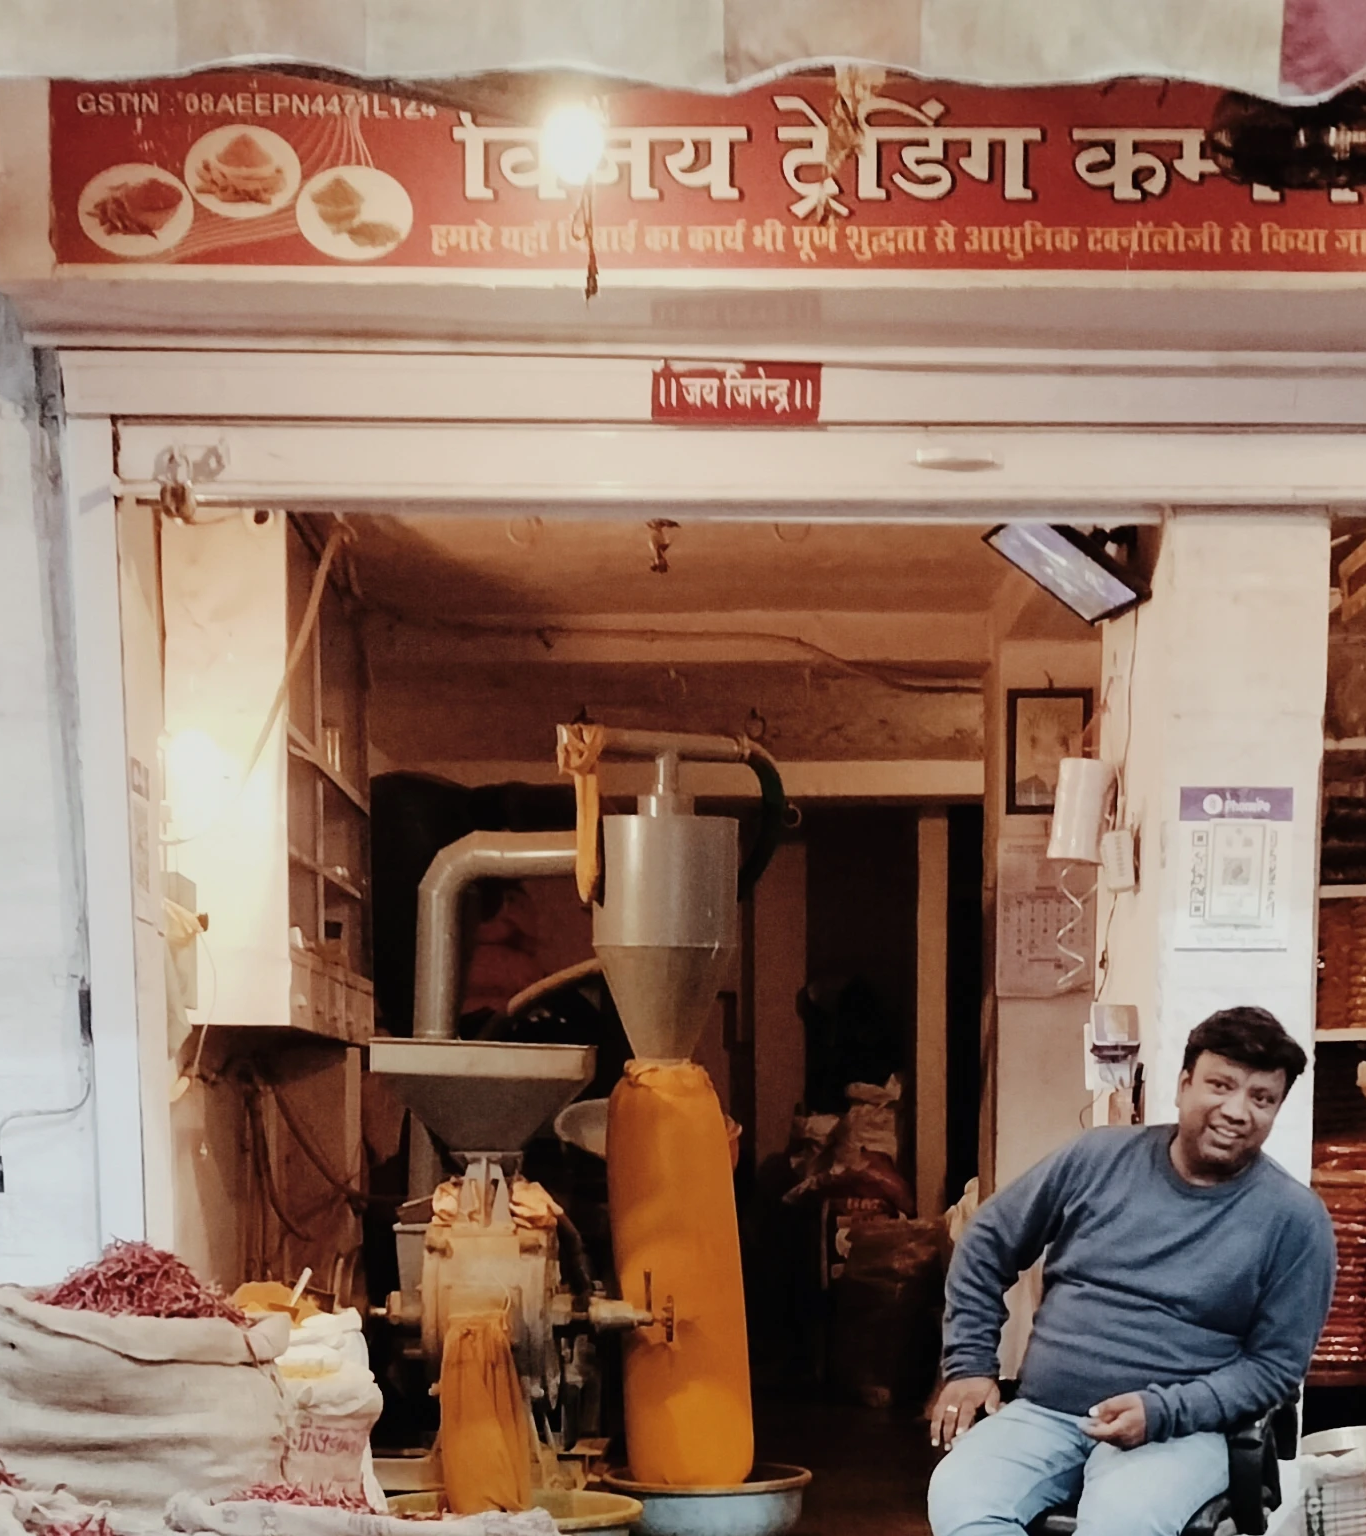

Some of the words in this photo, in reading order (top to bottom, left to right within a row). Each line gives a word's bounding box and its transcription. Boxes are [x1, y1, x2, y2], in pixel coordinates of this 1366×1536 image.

[77, 92, 160, 115] GSTIN
[772, 95, 1041, 219] ट्रेडिंग
[430, 219, 493, 257] हमारे
[644, 226, 682, 253] का
[687, 218, 747, 254] कार्य
[752, 218, 785, 253] भी
[791, 216, 838, 262] पूर्ण
[845, 225, 928, 261] शुद्धता
[934, 220, 957, 253] से
[963, 220, 1082, 261] आधुनिक
[1230, 221, 1252, 253] से
[1260, 221, 1329, 255] किया
